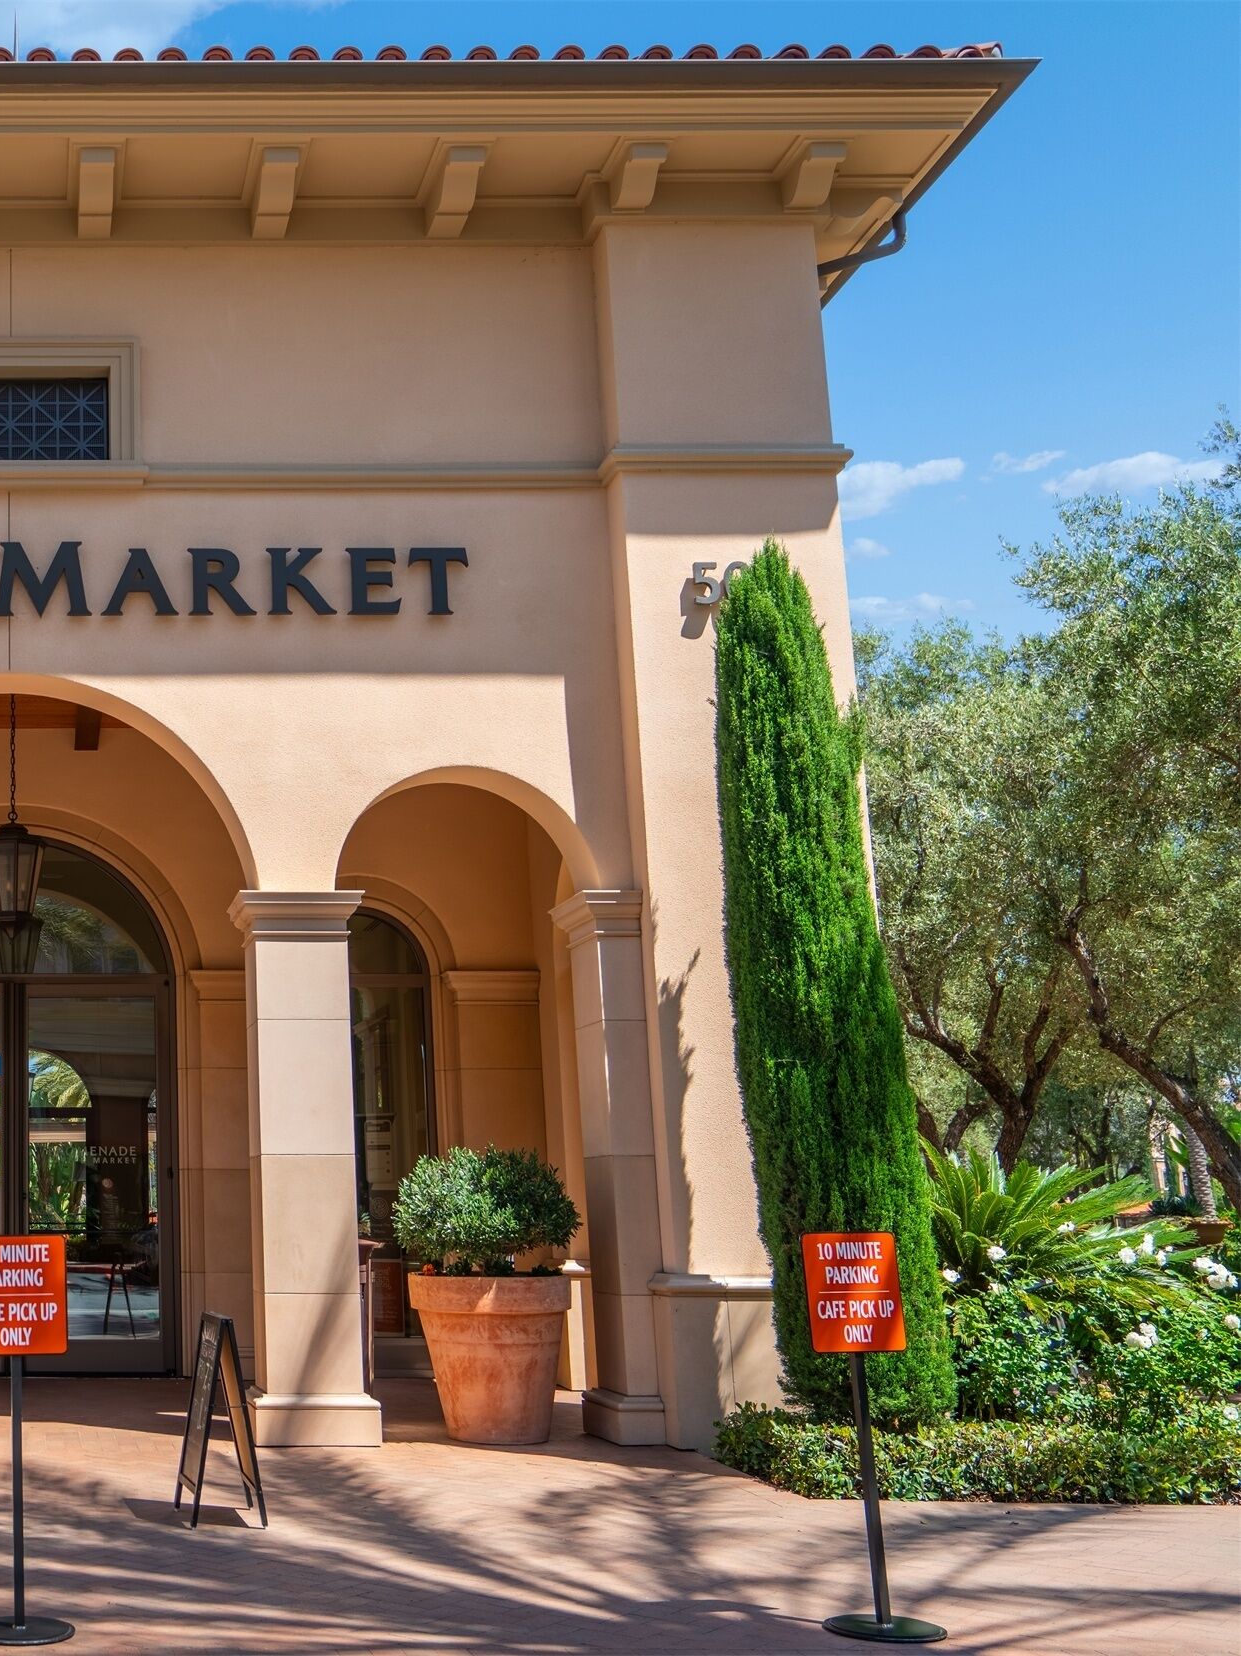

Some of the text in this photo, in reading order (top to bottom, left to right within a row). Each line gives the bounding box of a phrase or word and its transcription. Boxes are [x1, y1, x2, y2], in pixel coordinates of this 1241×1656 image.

[93, 1157, 137, 1165] MARKET
[0, 1243, 50, 1263] MINUTE
[816, 1241, 883, 1260] 10 MINUTE
[825, 1265, 879, 1285] PARKING
[8, 1302, 38, 1322] PICK
[40, 1302, 58, 1321] UP
[817, 1299, 895, 1319] CAFE PICK UP
[0, 1326, 33, 1347] ONLY
[843, 1324, 873, 1344] ONLY
